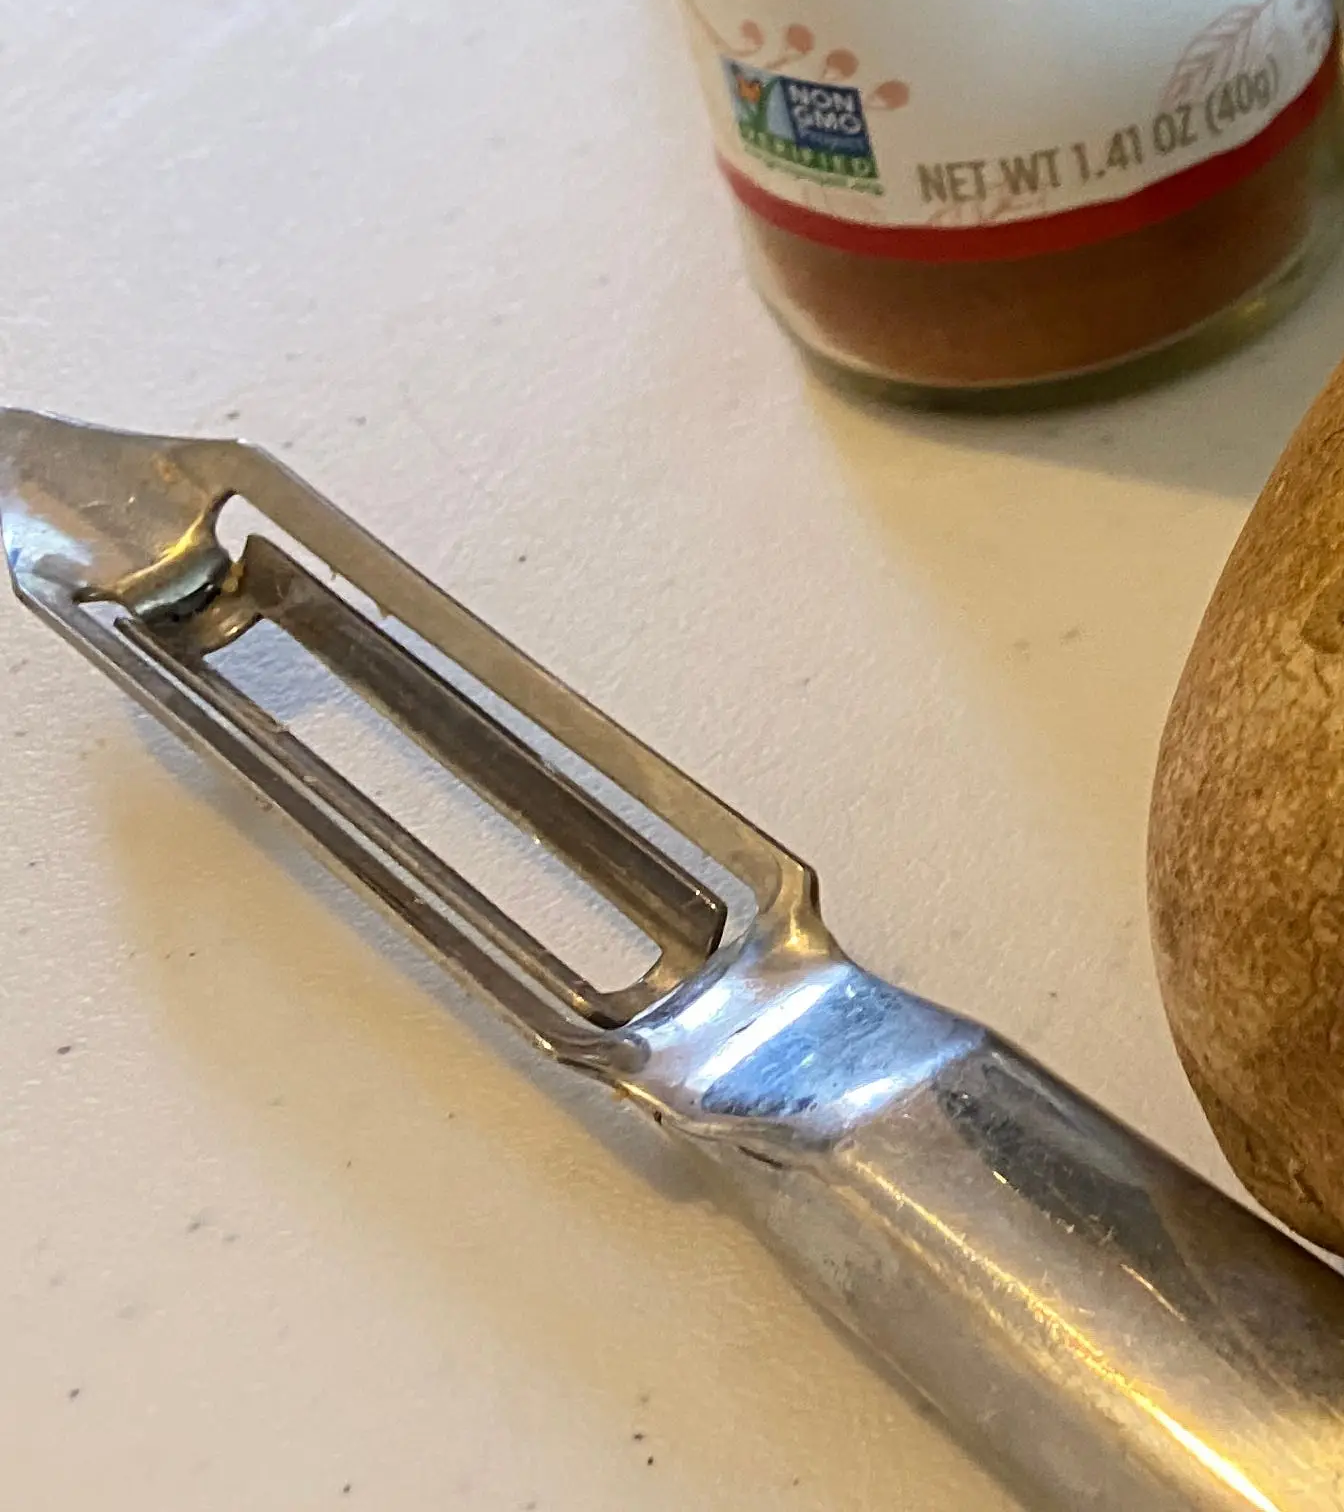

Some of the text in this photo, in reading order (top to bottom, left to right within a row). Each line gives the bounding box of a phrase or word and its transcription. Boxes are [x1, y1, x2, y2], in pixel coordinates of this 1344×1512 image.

[788, 85, 857, 113] NON
[793, 104, 863, 135] GMO
[915, 160, 987, 203] NET
[1000, 147, 1062, 196] WT
[1070, 125, 1144, 184] 1.41
[1152, 102, 1198, 157] OZ
[1205, 53, 1281, 135] (40g)
